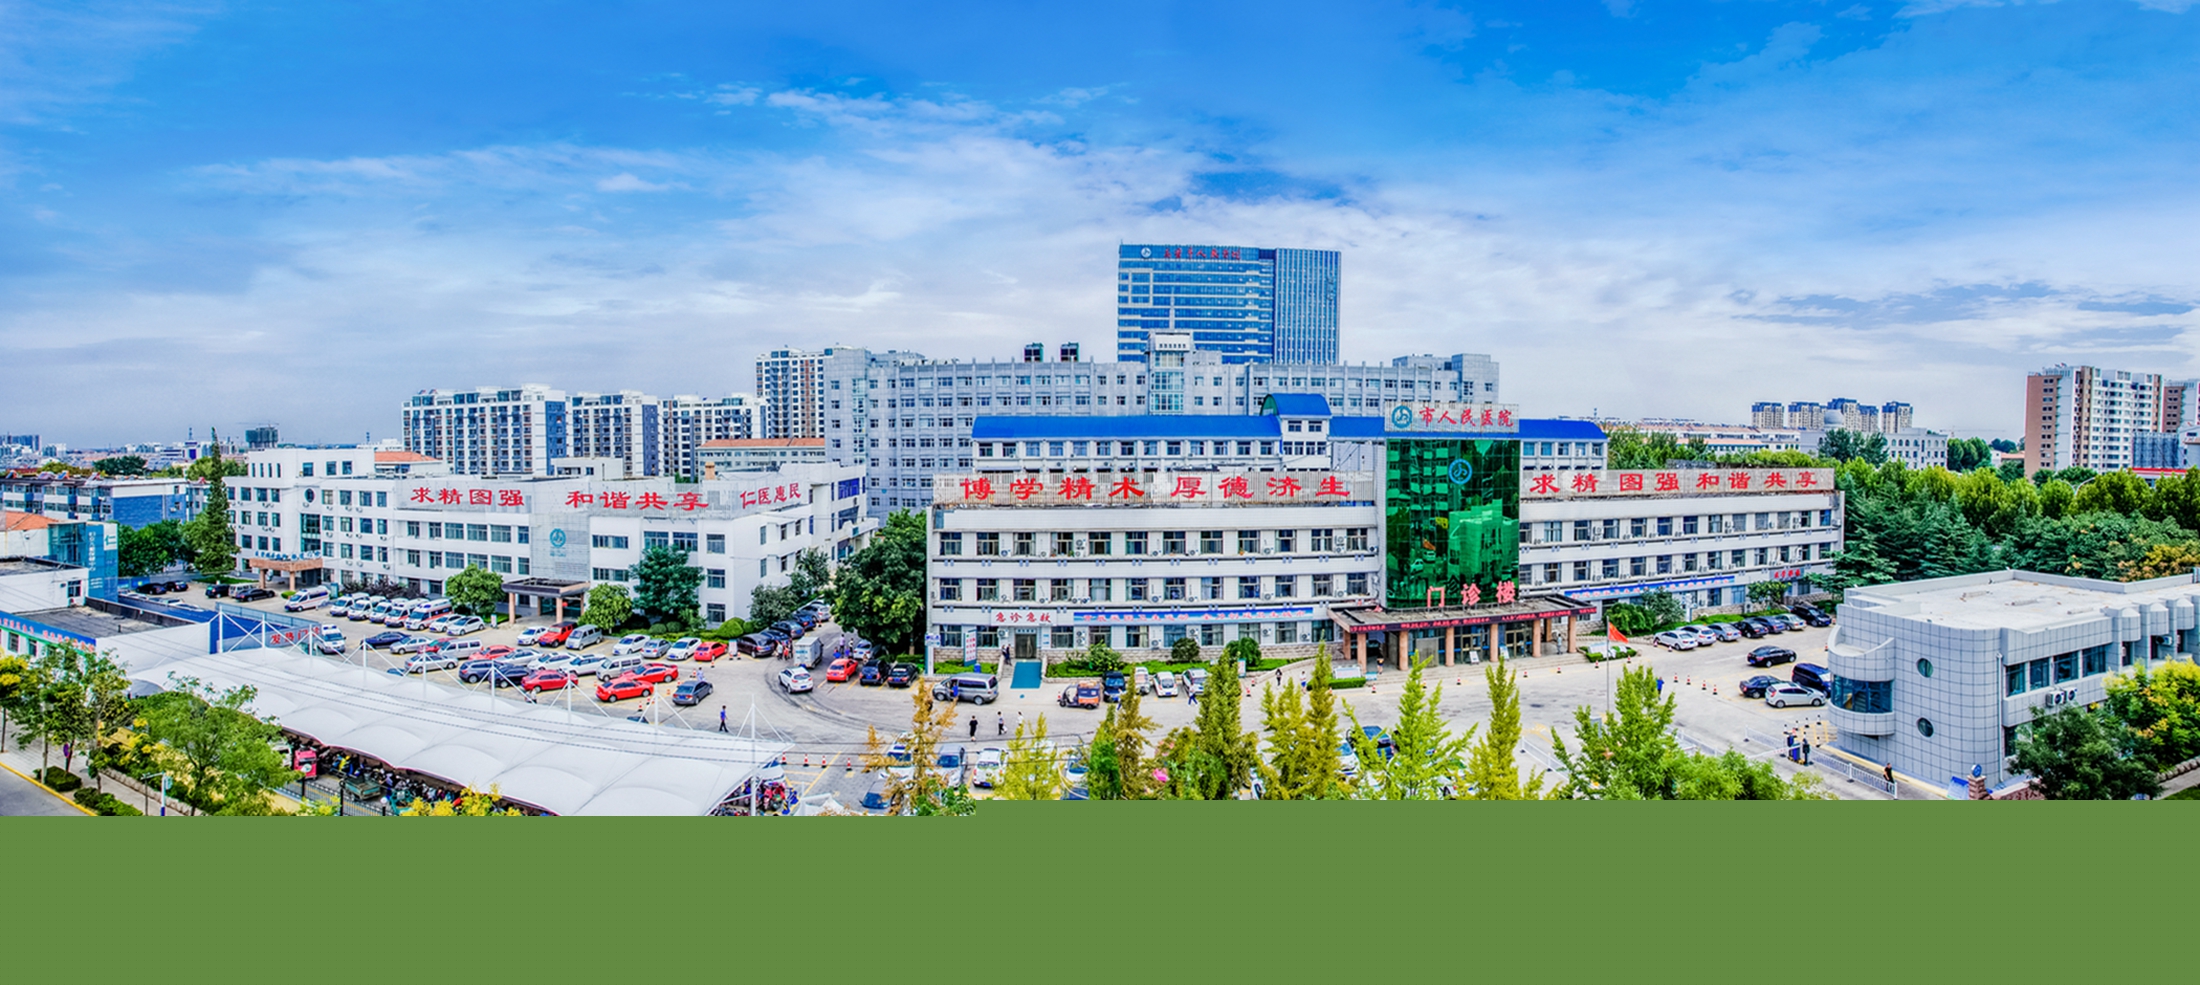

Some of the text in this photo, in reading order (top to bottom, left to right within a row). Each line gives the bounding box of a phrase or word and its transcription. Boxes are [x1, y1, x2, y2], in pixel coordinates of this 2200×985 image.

[1419, 406, 1514, 427] 市人民医院
[410, 487, 709, 512] 求精图强 和谐共享
[740, 485, 801, 508] 仁医惠民
[1427, 580, 1515, 608] 门诊楼
[995, 611, 1052, 623] 急诊急救
